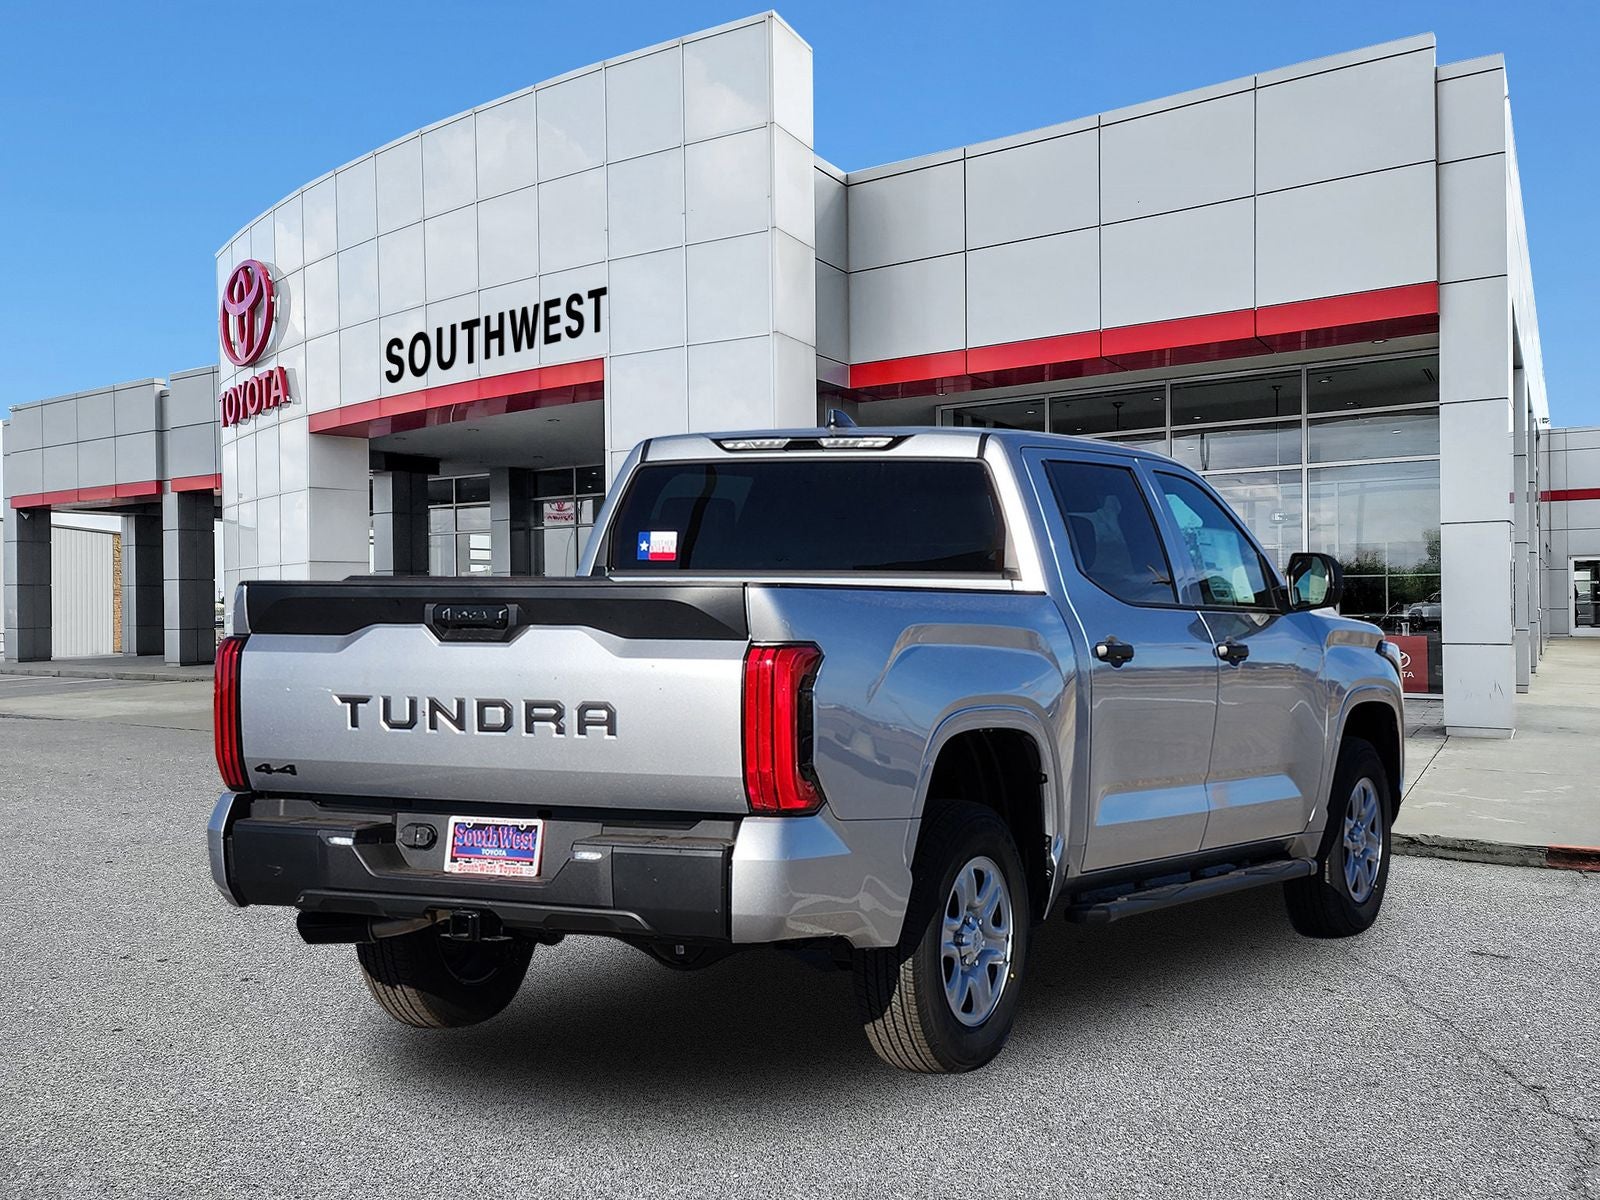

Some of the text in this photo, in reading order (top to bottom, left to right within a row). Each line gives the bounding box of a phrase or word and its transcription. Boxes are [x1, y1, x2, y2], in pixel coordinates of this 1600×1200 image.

[385, 286, 607, 384] SOUTHWEST
[219, 366, 291, 428] TOYOTA
[333, 694, 617, 739] TUNDRA
[480, 848, 507, 856] TOYOTA
